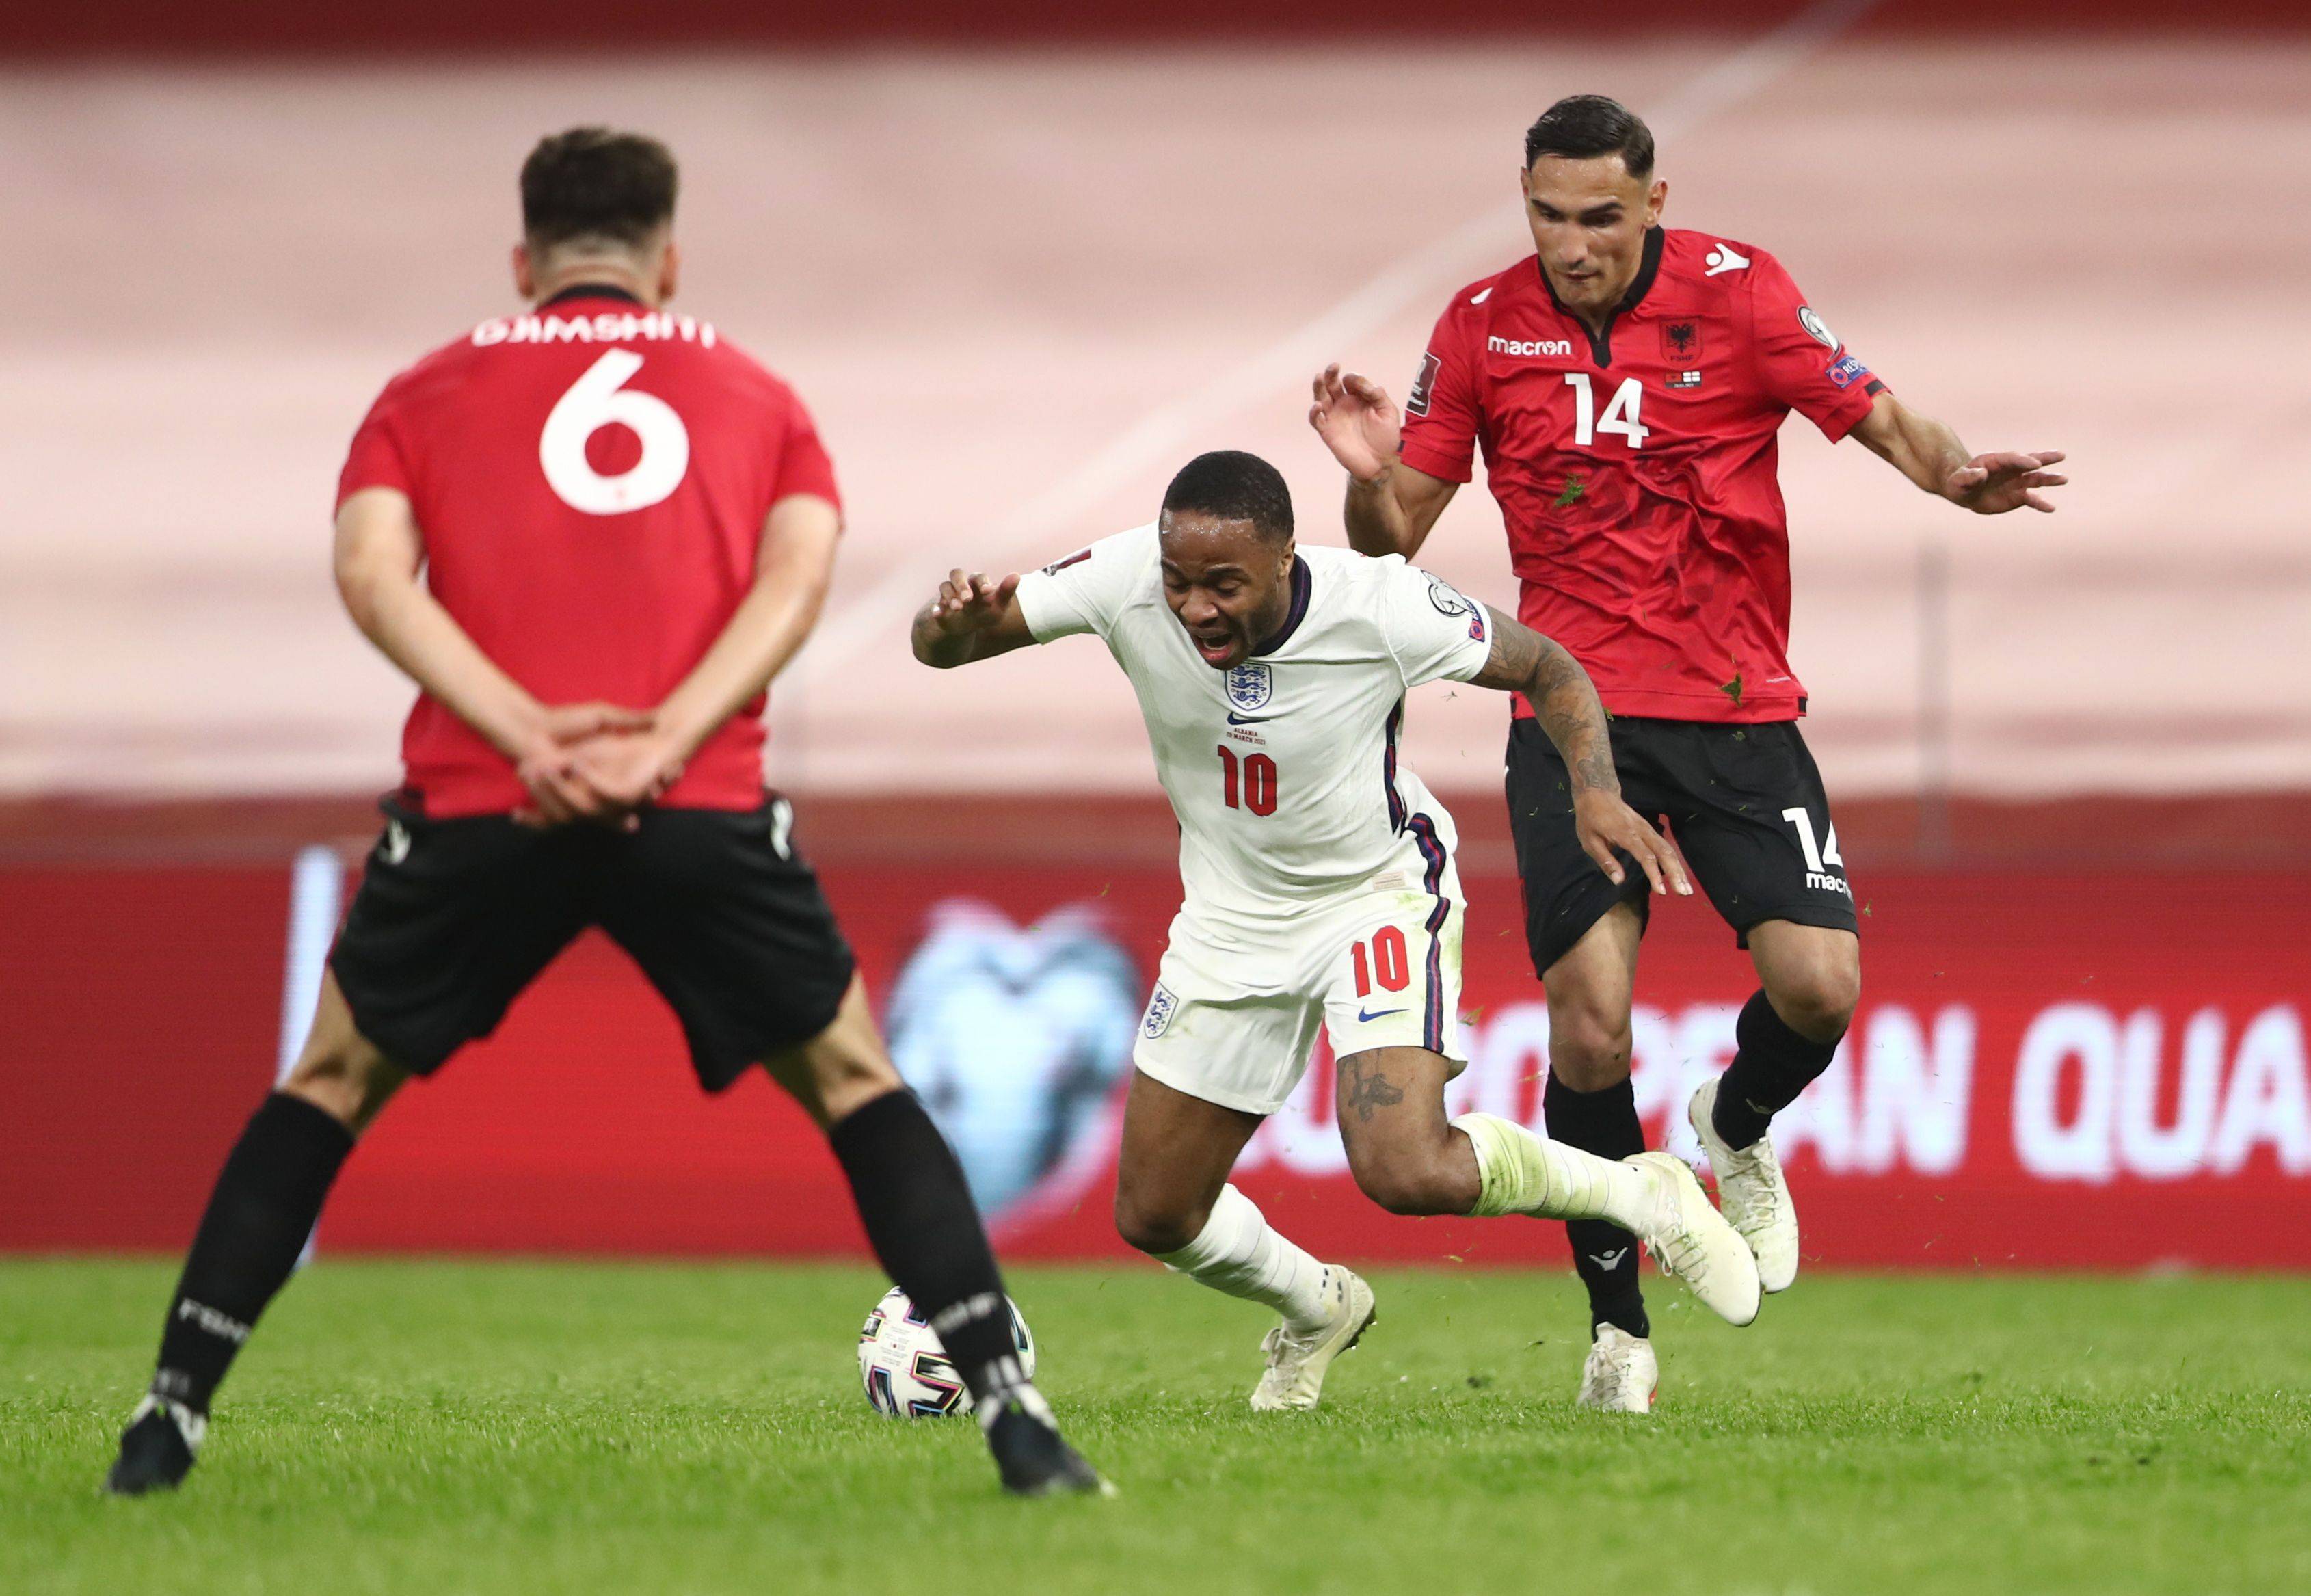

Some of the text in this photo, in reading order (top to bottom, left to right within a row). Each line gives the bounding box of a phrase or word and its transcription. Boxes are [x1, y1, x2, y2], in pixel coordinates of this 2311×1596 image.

[1488, 336, 1571, 356] macron
[539, 347, 690, 515] 6
[1565, 373, 1649, 449] 14
[1233, 734, 1253, 743] MARCH
[1234, 728, 1258, 736] ALBANIA
[1218, 744, 1277, 816] 10
[1351, 925, 1410, 998] 10
[2010, 1002, 2311, 1186] QUA
